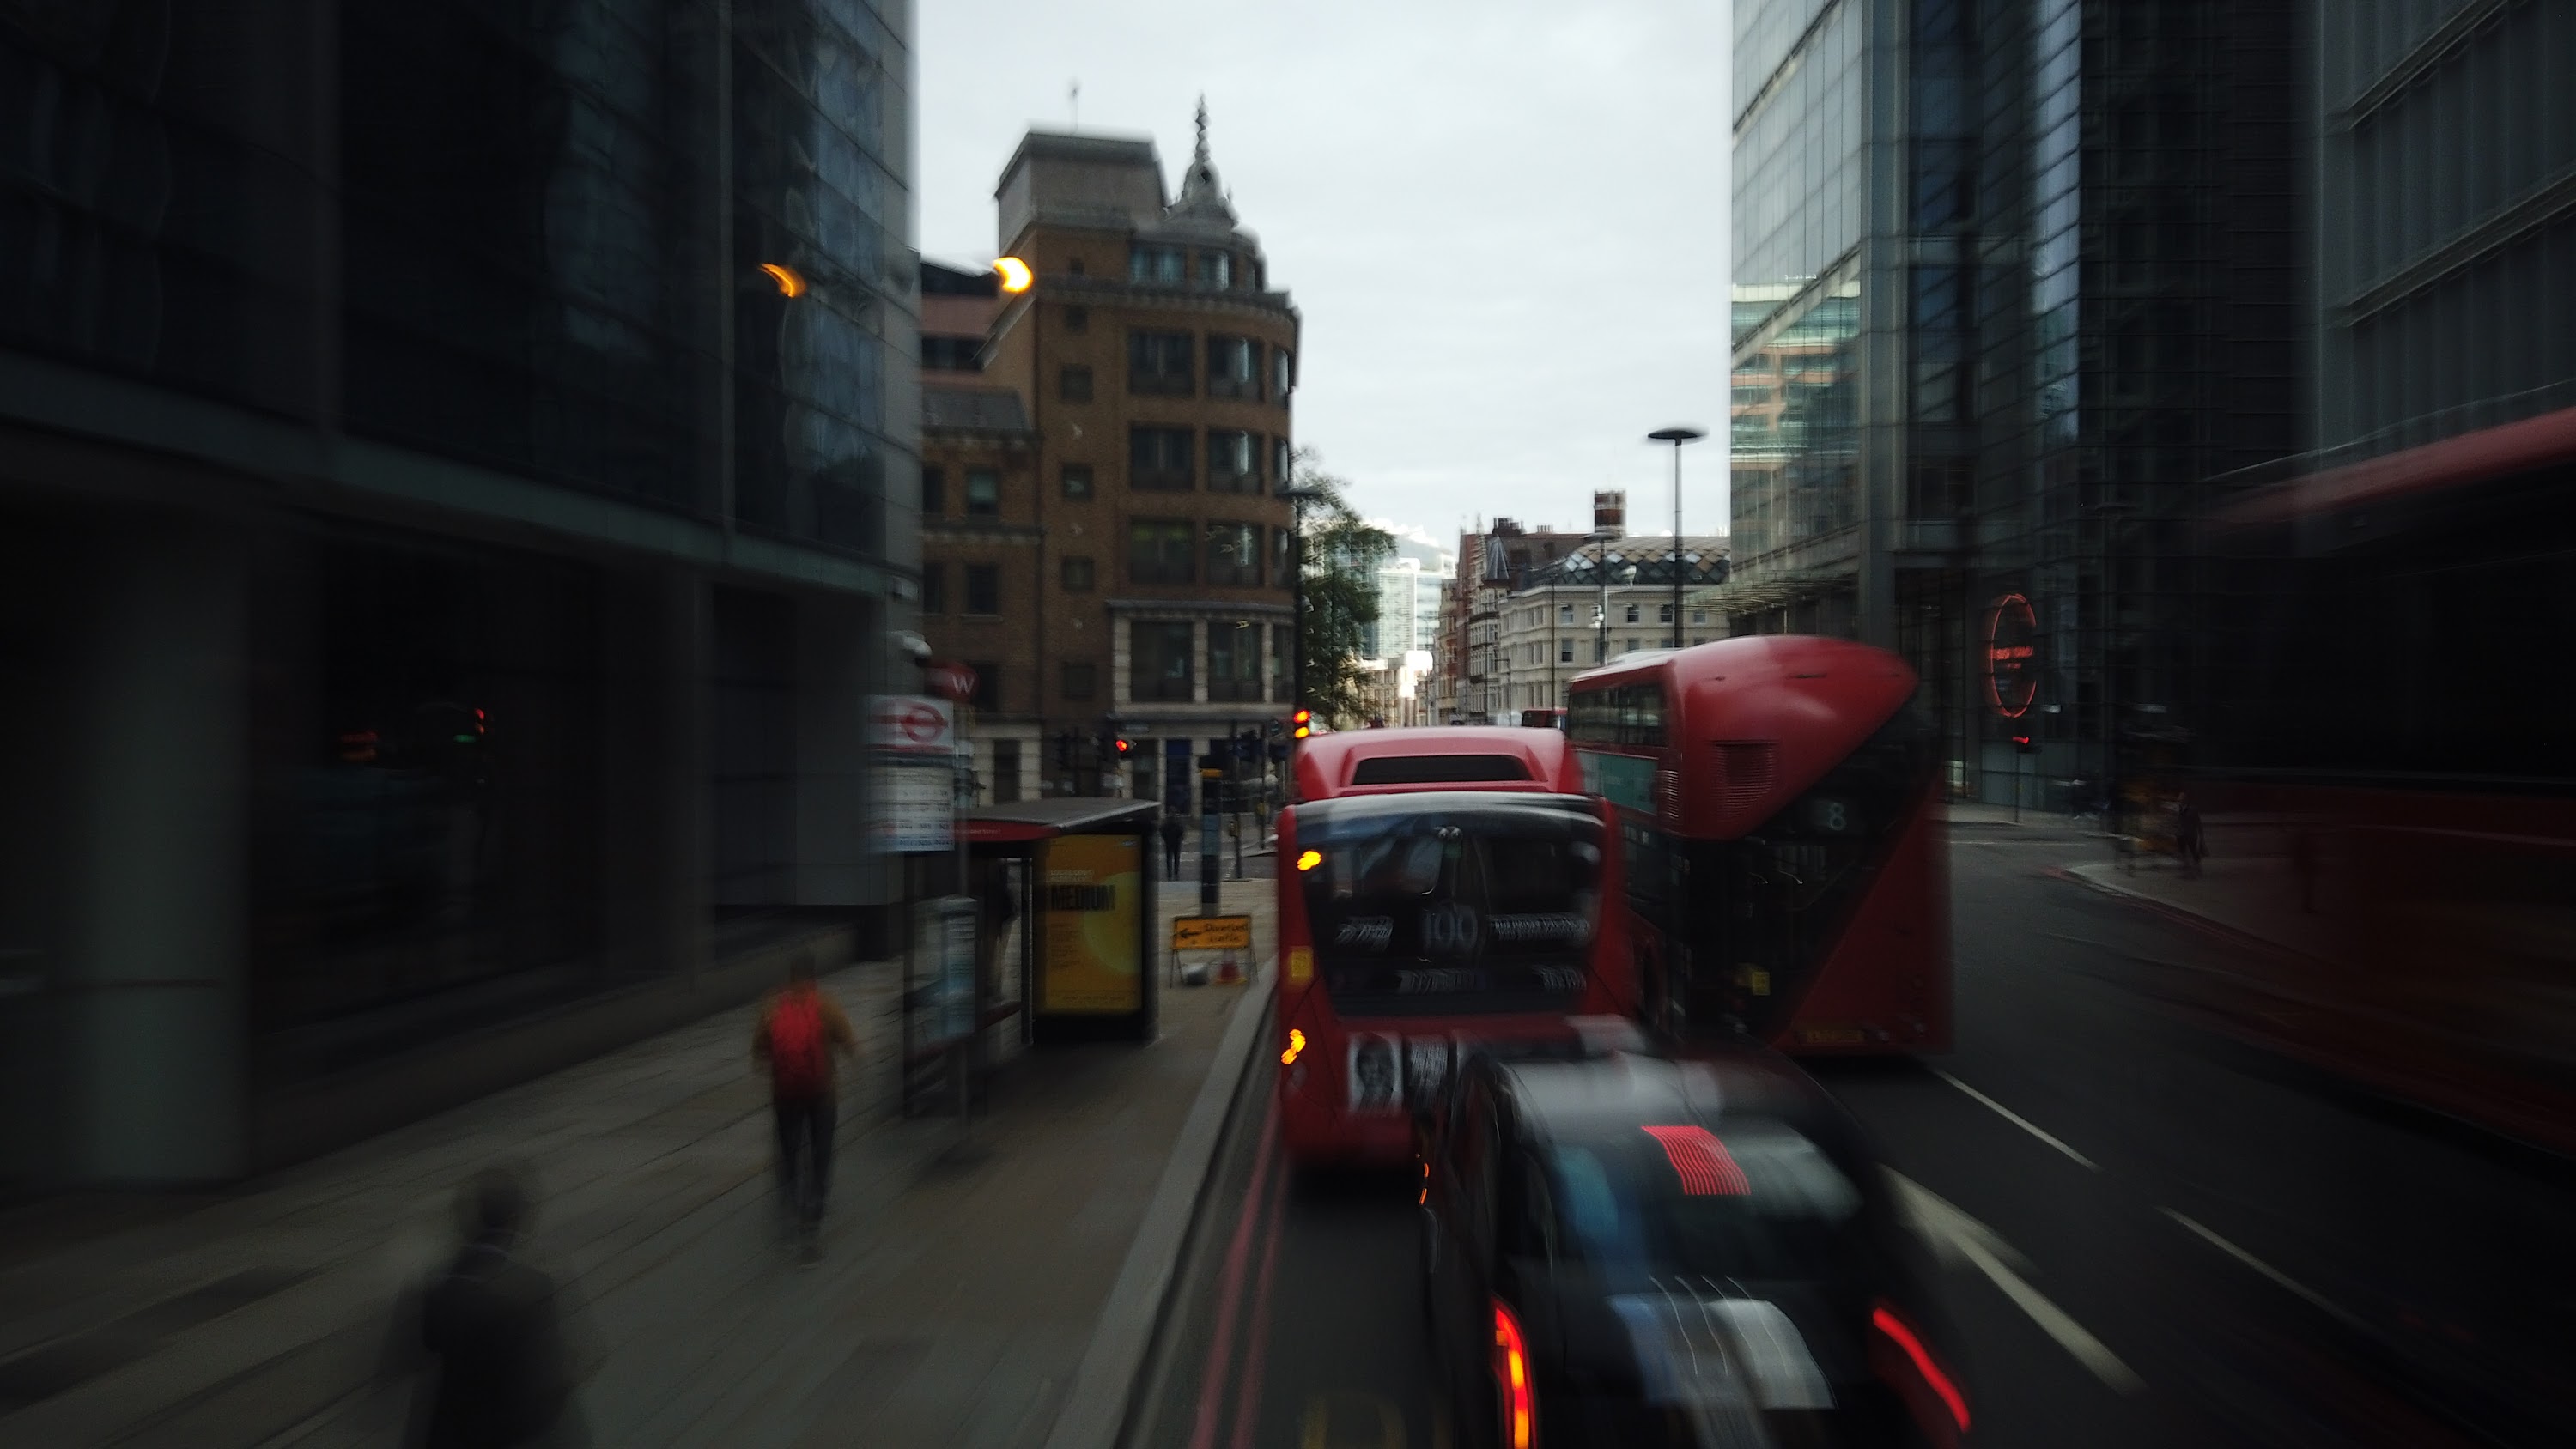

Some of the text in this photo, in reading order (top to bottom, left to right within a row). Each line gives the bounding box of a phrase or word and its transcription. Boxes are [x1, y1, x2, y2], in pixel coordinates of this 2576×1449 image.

[951, 674, 975, 694] W
[1828, 801, 1846, 831] 8
[1051, 884, 1115, 911] MEDIUM
[1422, 906, 1478, 952] 100
